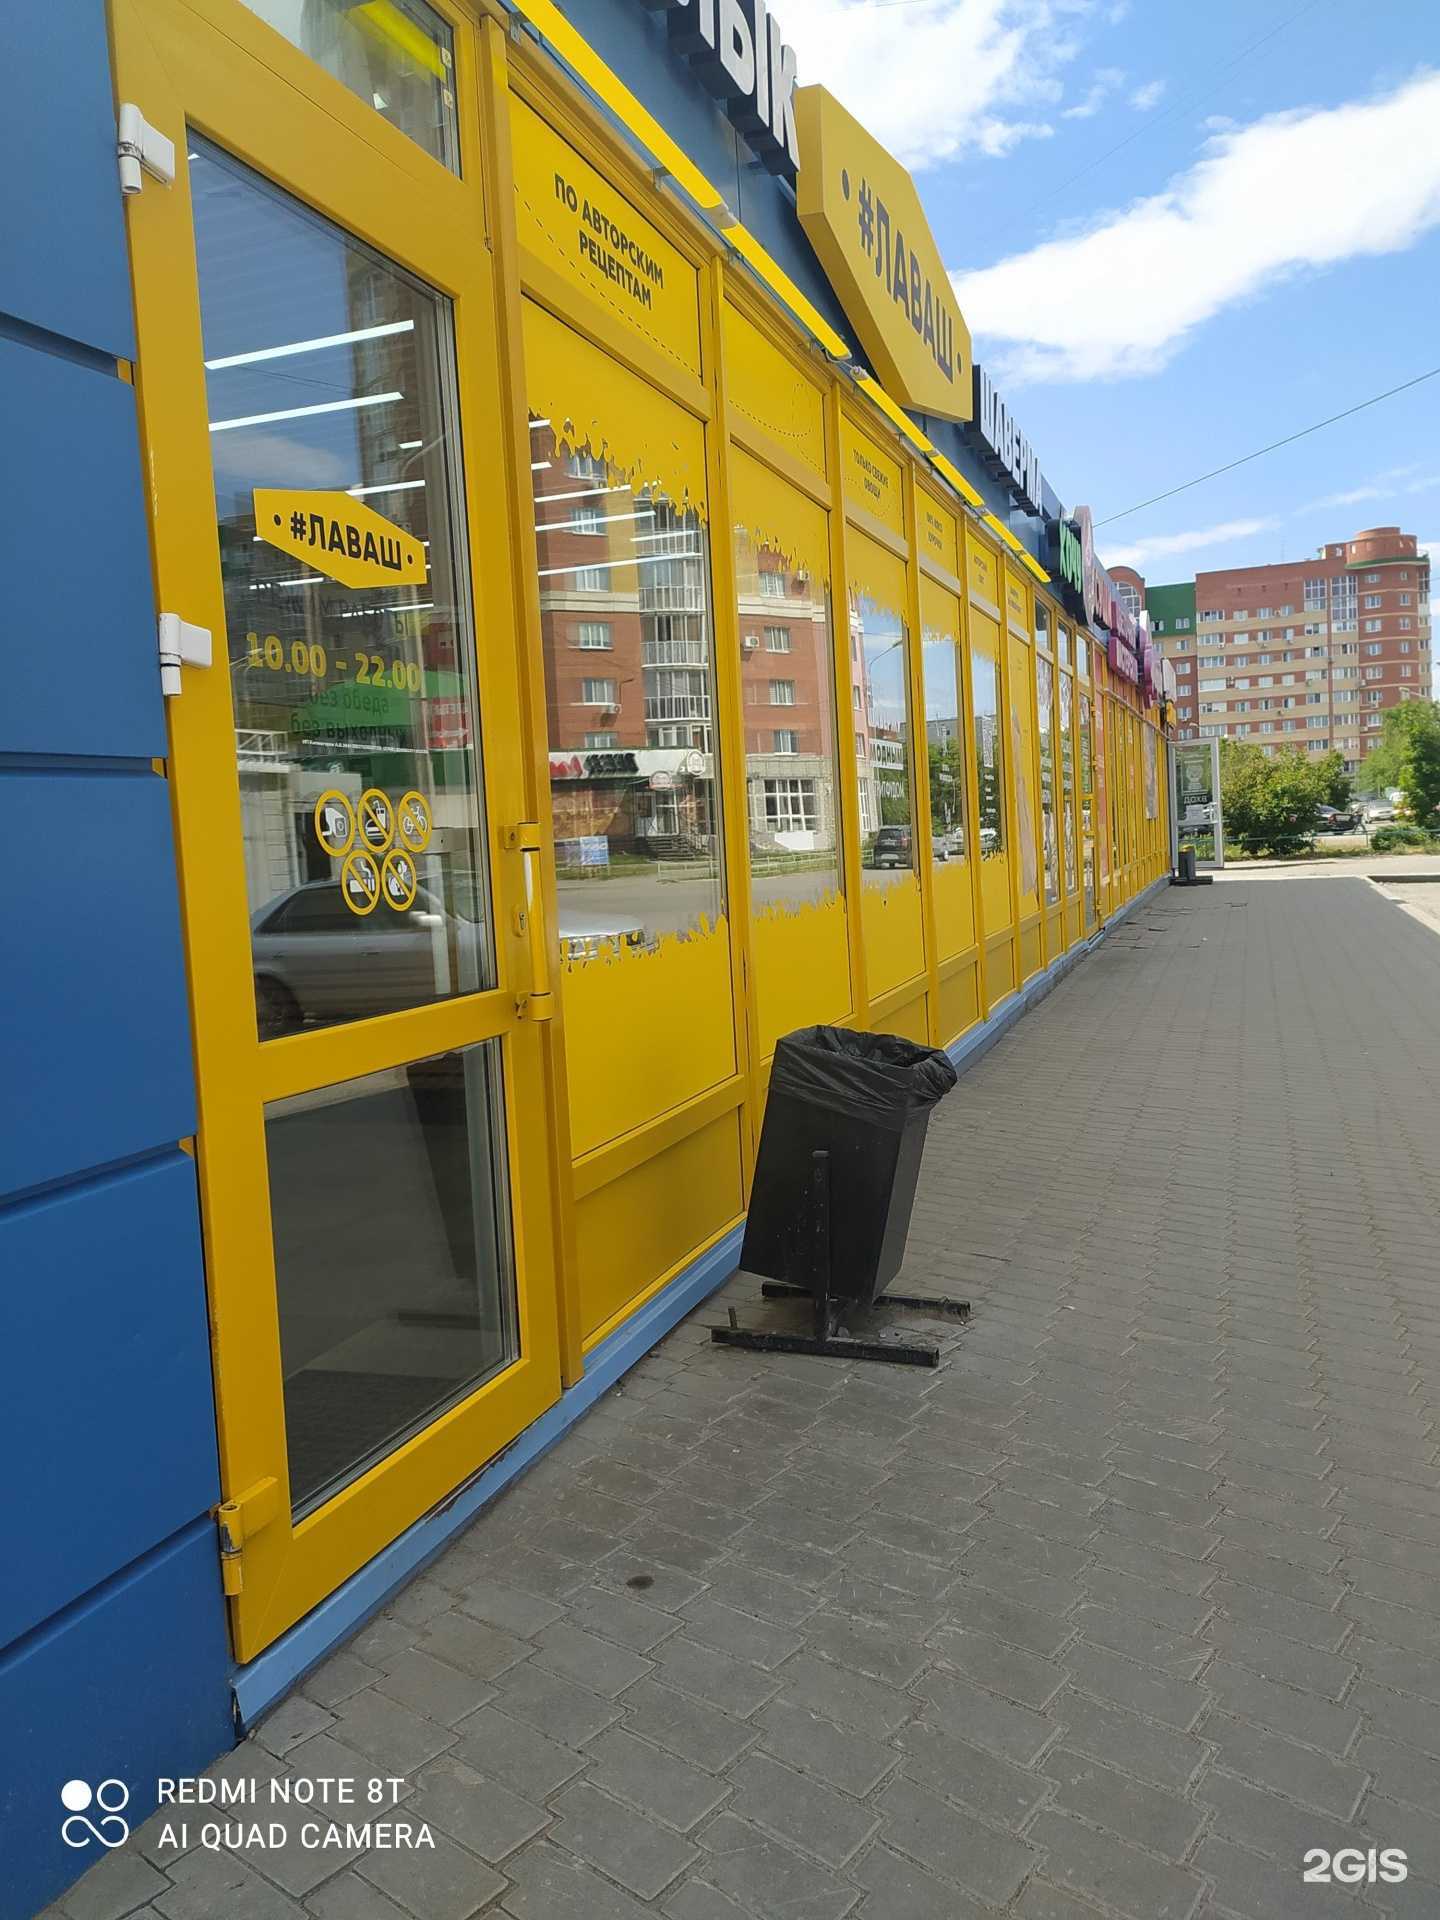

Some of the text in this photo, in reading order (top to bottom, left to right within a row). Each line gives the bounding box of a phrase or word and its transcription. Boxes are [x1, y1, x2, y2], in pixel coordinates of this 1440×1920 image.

[676, 0, 800, 172] ЫК
[554, 172, 664, 289] ПО АВТОРСКИМ
[579, 229, 652, 311] РЕЦЕПТАМ
[858, 177, 954, 385] #ЛАВАШ
[290, 510, 402, 571] #ЛАВАШ
[246, 632, 327, 678] 10.00
[355, 653, 421, 692] 22.00
[290, 712, 320, 738] без
